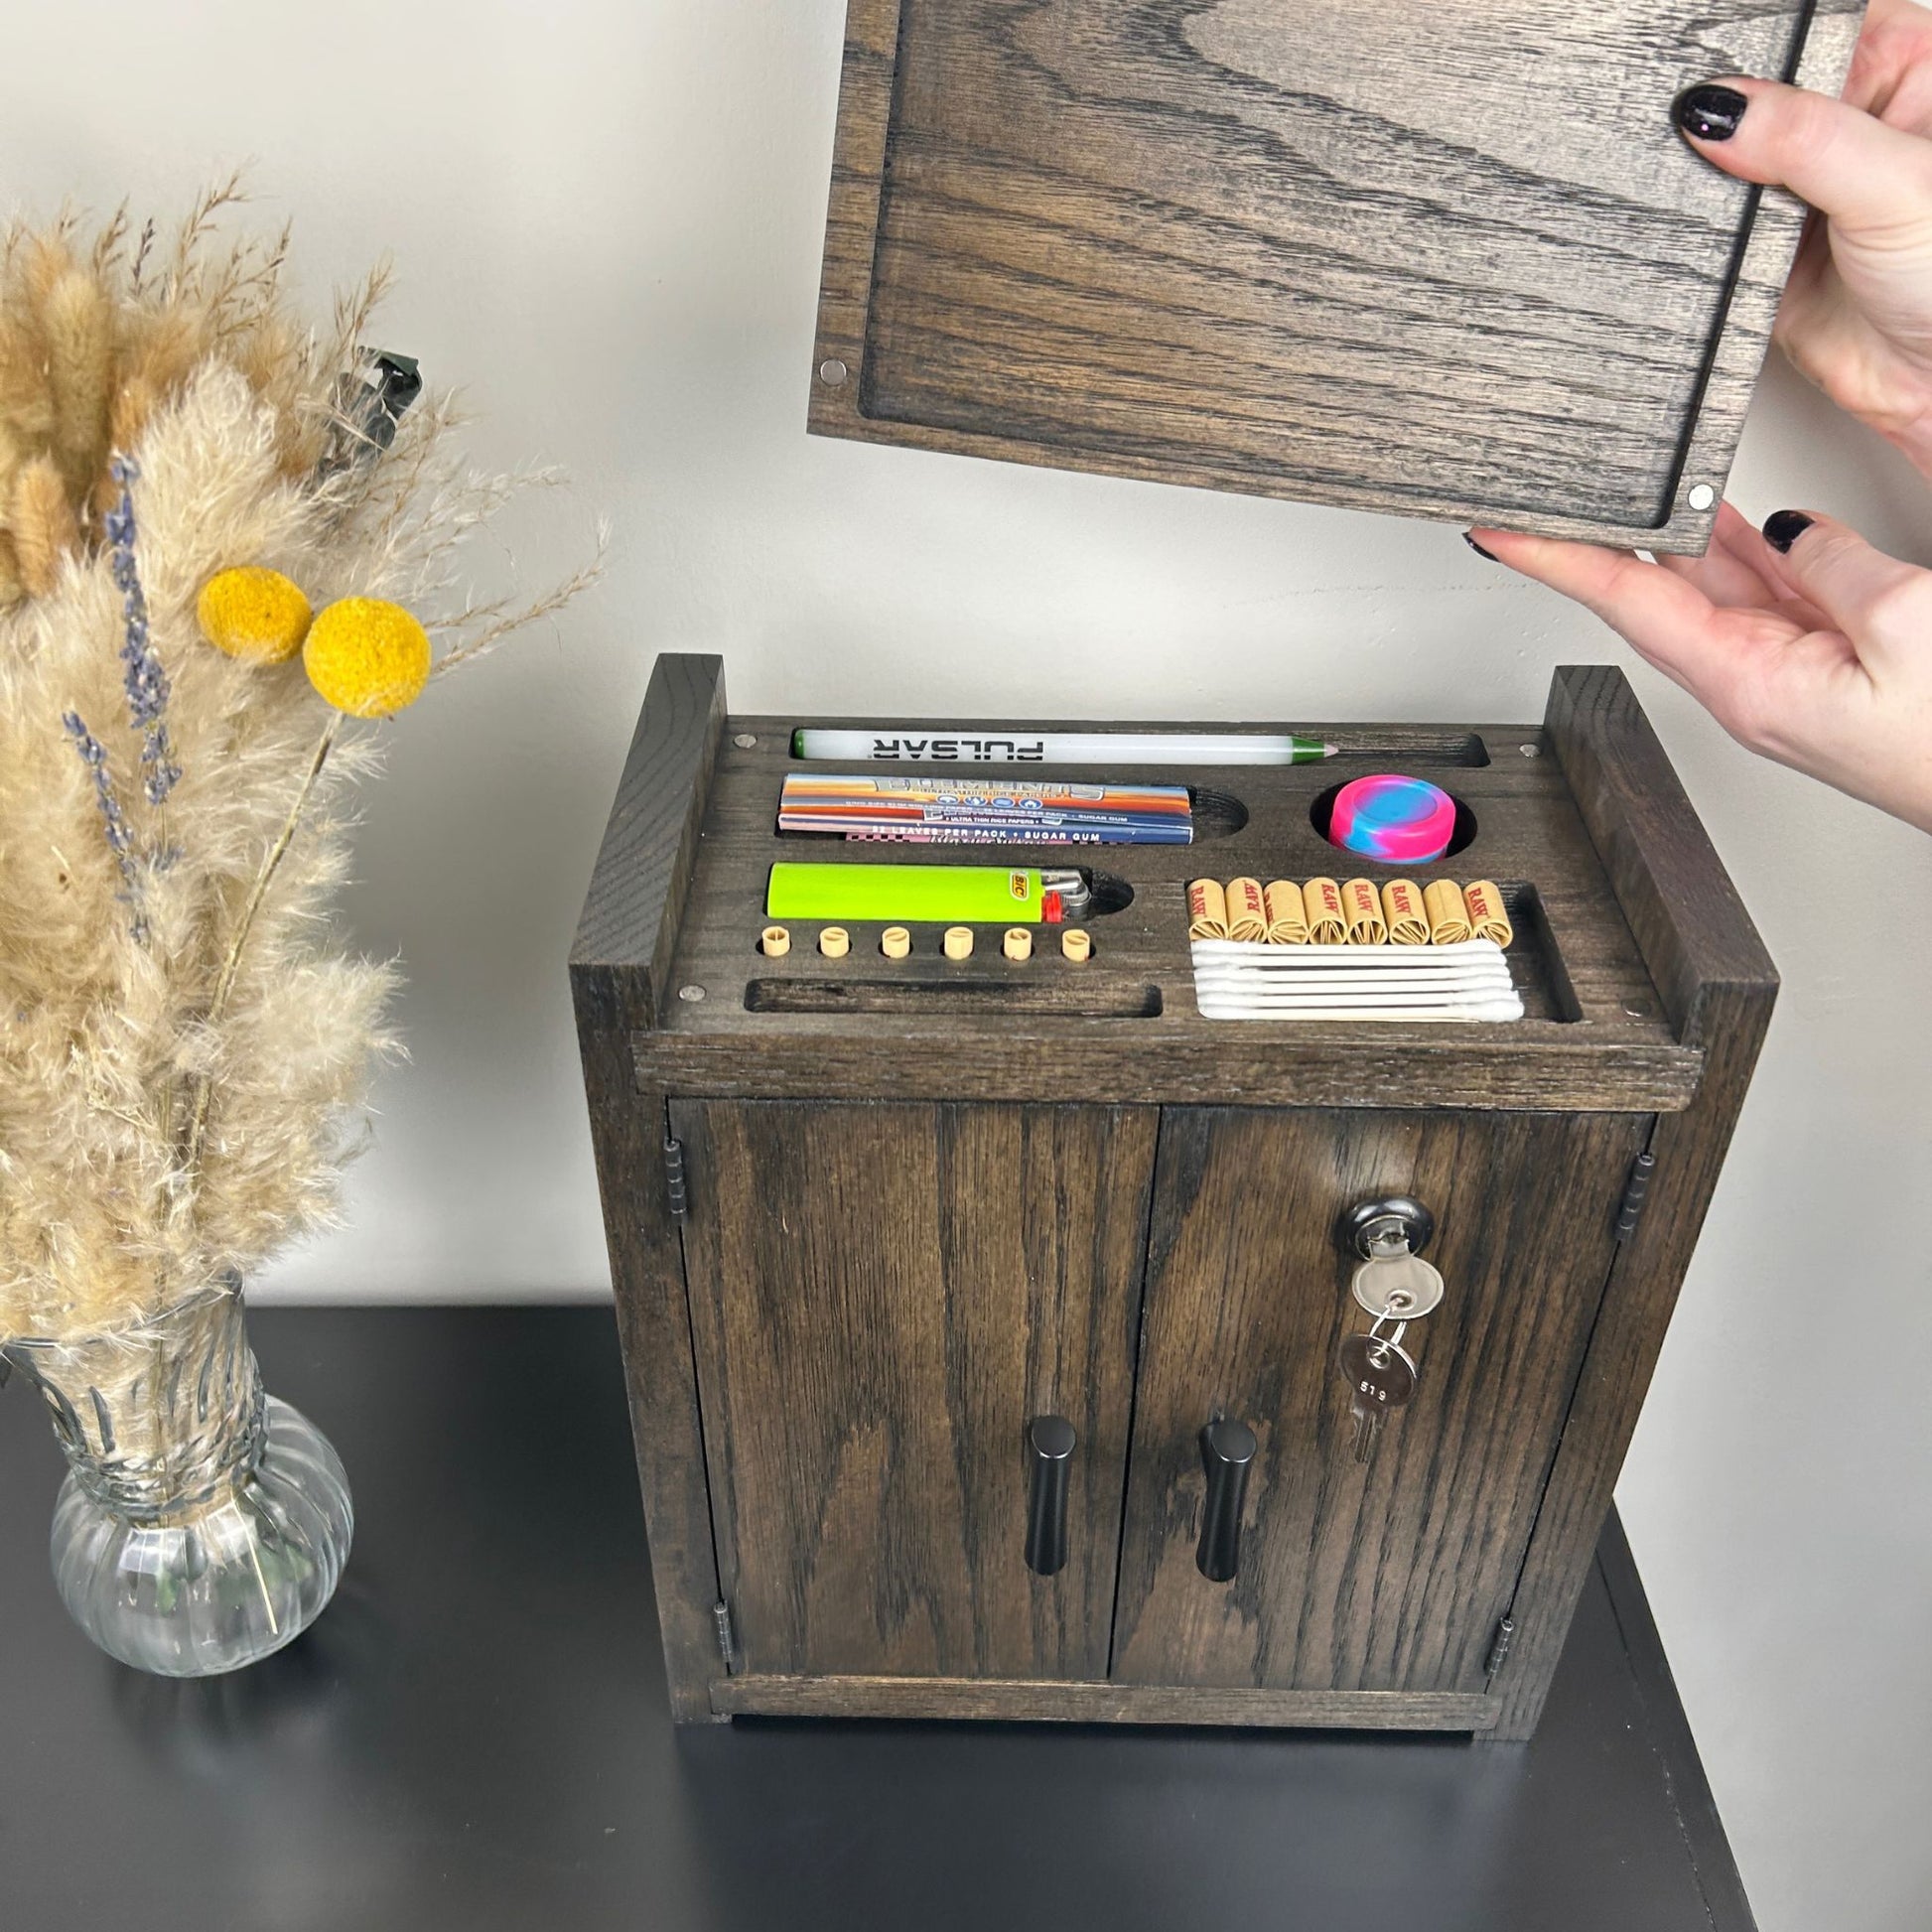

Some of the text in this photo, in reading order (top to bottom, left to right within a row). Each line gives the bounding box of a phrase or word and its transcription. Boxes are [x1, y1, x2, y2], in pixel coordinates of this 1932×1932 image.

[874, 740, 1043, 760] PULSAR
[893, 826, 938, 835] LEAVES
[1025, 831, 1066, 840] SUGAR
[1015, 875, 1025, 897] BIC
[1191, 886, 1207, 915] RAW
[1244, 883, 1261, 914] RAW
[1321, 884, 1340, 913] RAW
[1354, 884, 1374, 913] RAW
[1392, 885, 1413, 914] RAW
[1468, 887, 1489, 917] RAW
